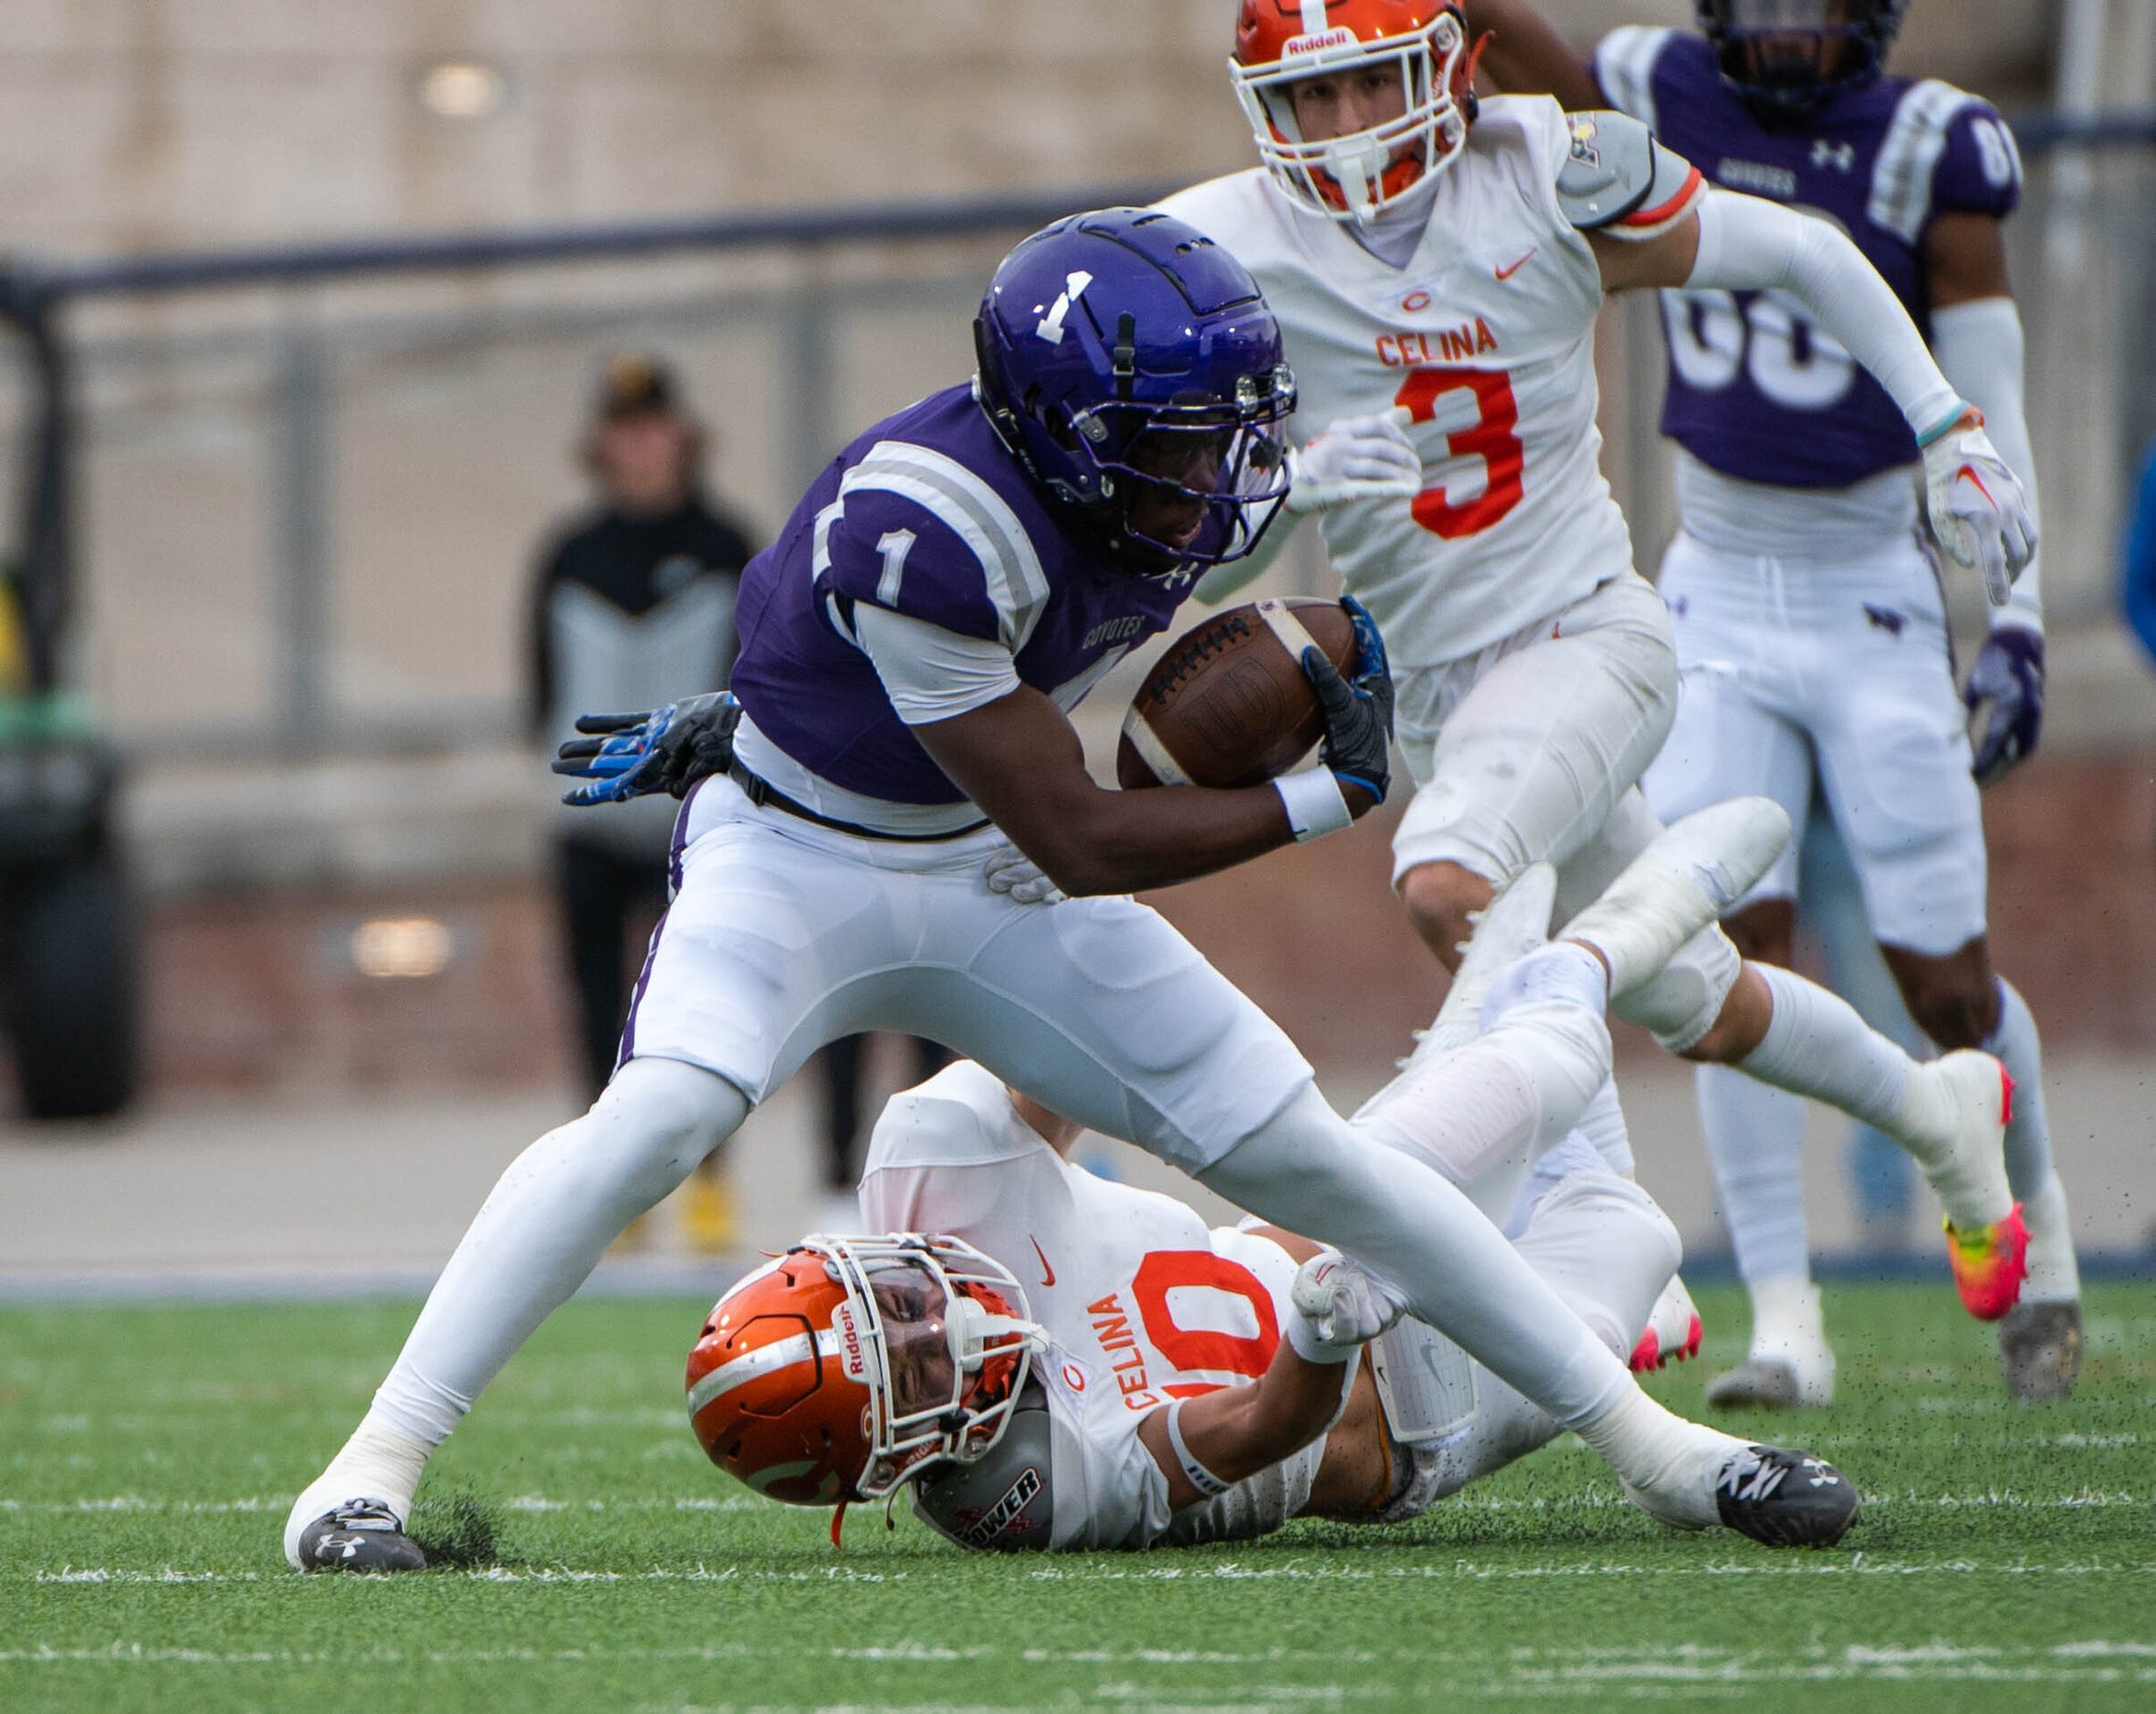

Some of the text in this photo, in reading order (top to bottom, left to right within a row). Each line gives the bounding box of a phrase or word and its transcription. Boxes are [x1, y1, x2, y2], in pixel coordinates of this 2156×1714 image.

[1288, 31, 1348, 57] Riddell
[1036, 270, 1093, 345] 1
[1375, 316, 1498, 368] CELINA
[1395, 366, 1524, 540] 3
[875, 528, 917, 608] 1
[1082, 615, 1146, 651] COYOTES
[840, 1305, 863, 1374] Riddell
[1086, 1292, 1161, 1411] CELINA
[1131, 1249, 1281, 1399] 0
